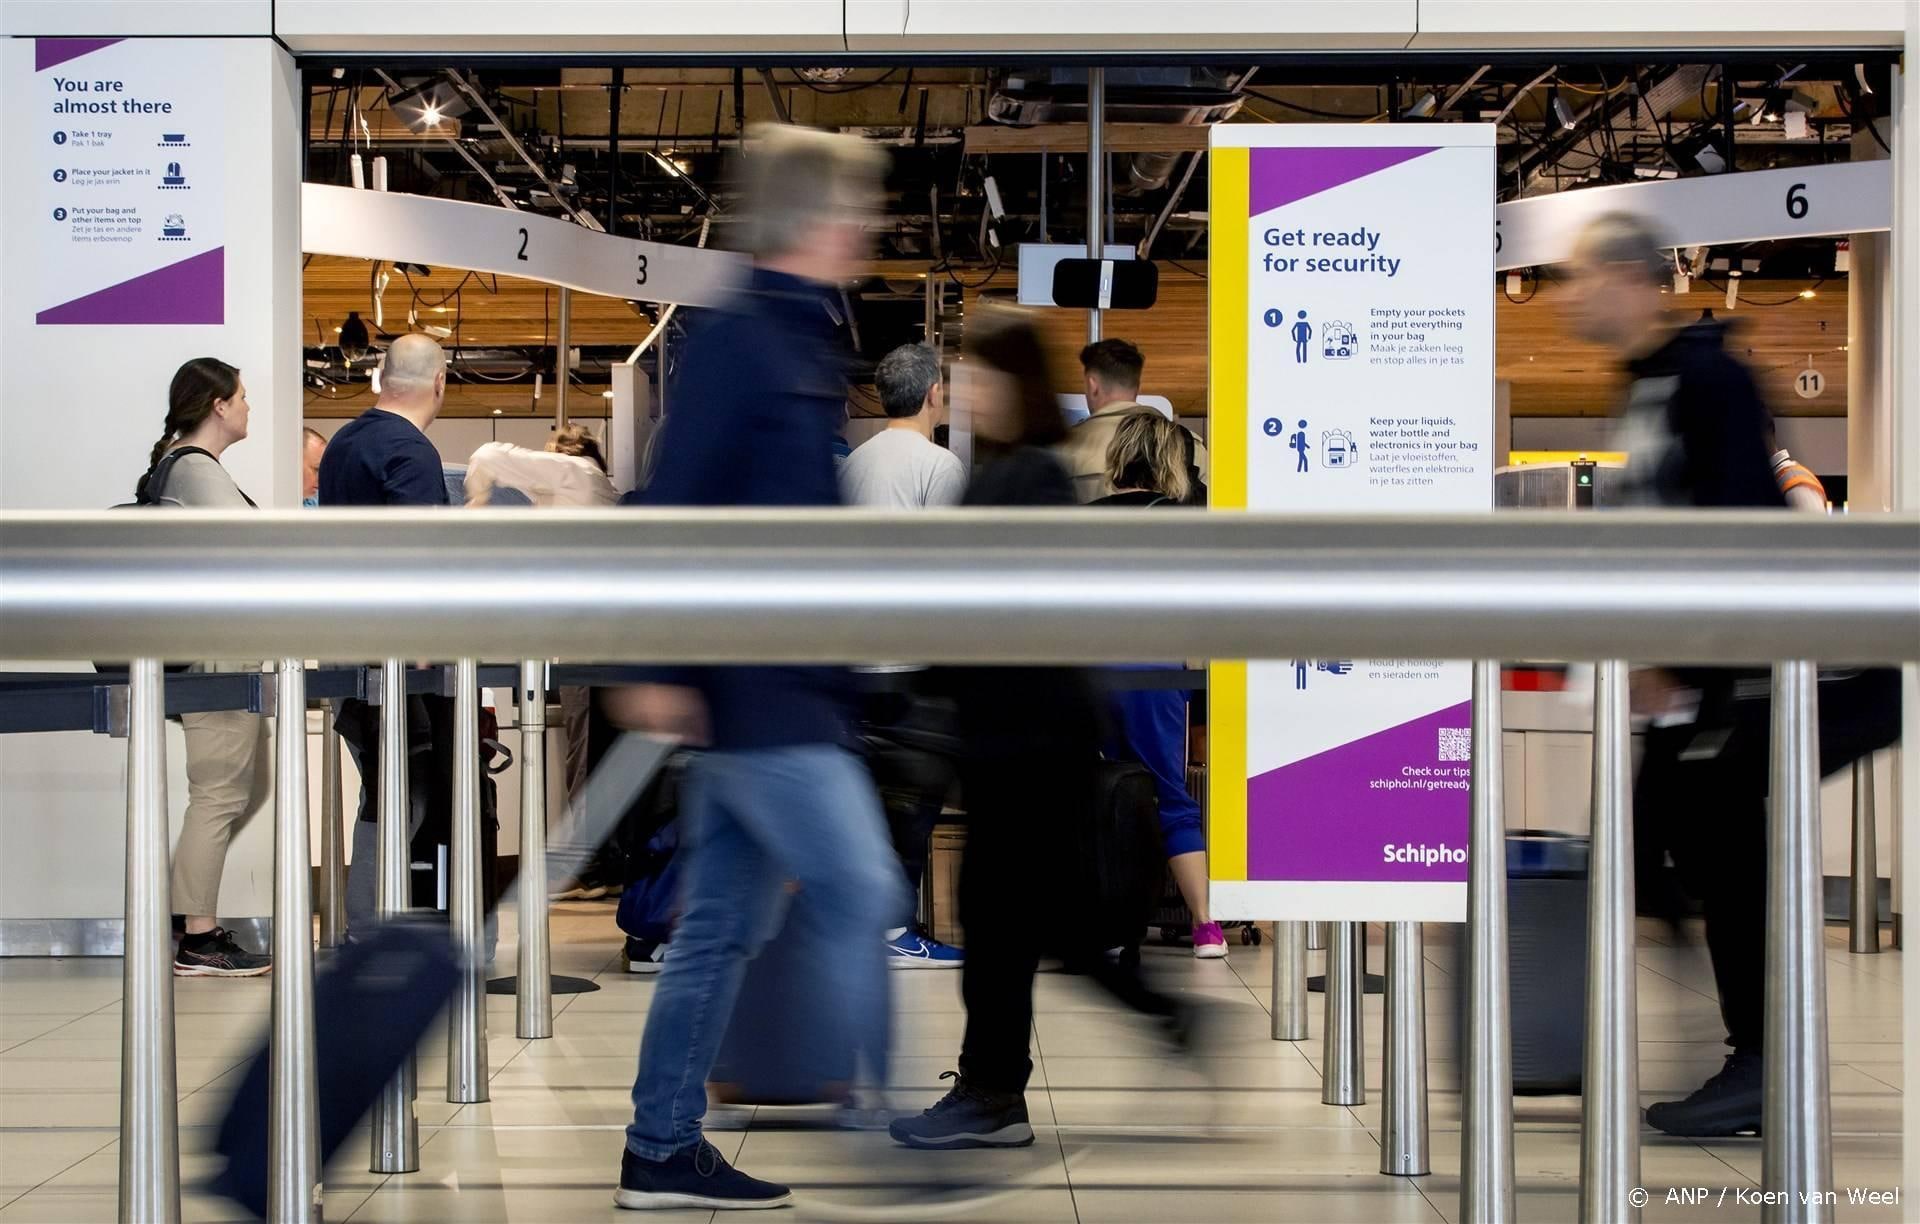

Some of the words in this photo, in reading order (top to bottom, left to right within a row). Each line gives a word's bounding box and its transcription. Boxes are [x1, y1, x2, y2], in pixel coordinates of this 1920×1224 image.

[53, 78, 88, 92] You
[94, 81, 123, 92] are
[53, 99, 117, 114] almost
[122, 99, 172, 114] there
[97, 131, 112, 140] tray
[72, 168, 91, 176] Place
[93, 170, 110, 178] your
[112, 168, 134, 177] jacket
[145, 168, 151, 176] it
[72, 178, 84, 186] Leg
[86, 178, 93, 187] je
[95, 178, 104, 187] jas
[1786, 183, 1809, 219] 6
[106, 207, 120, 216] bag
[128, 216, 142, 225] top
[85, 226, 92, 234] je
[117, 225, 142, 233] andere
[1264, 228, 1305, 246] Get
[1313, 227, 1380, 250] ready
[517, 228, 528, 261] 2
[636, 255, 647, 285] 3
[1263, 253, 1299, 272] for
[1306, 253, 1401, 277] security
[1370, 308, 1401, 318] Empty
[1404, 310, 1426, 318] your
[1428, 308, 1466, 318] pockets
[1370, 320, 1389, 328] and
[1392, 321, 1408, 330] put
[1410, 320, 1462, 331] everything
[1370, 332, 1380, 340] in
[1382, 334, 1404, 342] your
[1407, 332, 1425, 342] bag
[1370, 344, 1396, 352] Maak
[1398, 344, 1406, 354] je
[1409, 344, 1441, 352] zakken
[1444, 344, 1463, 354] leeg
[1384, 356, 1404, 366] stop
[1406, 356, 1427, 364] alles
[1429, 356, 1438, 364] in
[1440, 356, 1448, 366] je
[1799, 375, 1819, 391] 11
[1370, 417, 1394, 426] Keep
[1397, 419, 1418, 427] your
[1422, 417, 1456, 426] liquids,
[1370, 429, 1398, 437] water
[1400, 429, 1430, 437] bottle
[1432, 429, 1450, 437] and
[1370, 441, 1420, 449] electronics
[1424, 441, 1432, 449] in
[1434, 443, 1457, 451] your
[1460, 441, 1478, 451] bag
[1370, 453, 1390, 461] Laat
[1392, 453, 1400, 463] je
[1402, 453, 1459, 463] vloeistoffen,
[1370, 465, 1410, 473] waterfles
[1426, 465, 1474, 473] elektronica
[1370, 477, 1378, 485] in
[1380, 477, 1389, 487] je
[1408, 477, 1434, 485] zitten
[1369, 671, 1380, 679] en
[1382, 670, 1422, 679] sieraden
[1424, 671, 1440, 679] om
[1402, 766, 1432, 776] Check
[1434, 768, 1451, 776] our
[1453, 767, 1470, 778] tips
[1370, 779, 1470, 791] schiphol.nl/getready
[1384, 843, 1468, 867] Schipho
